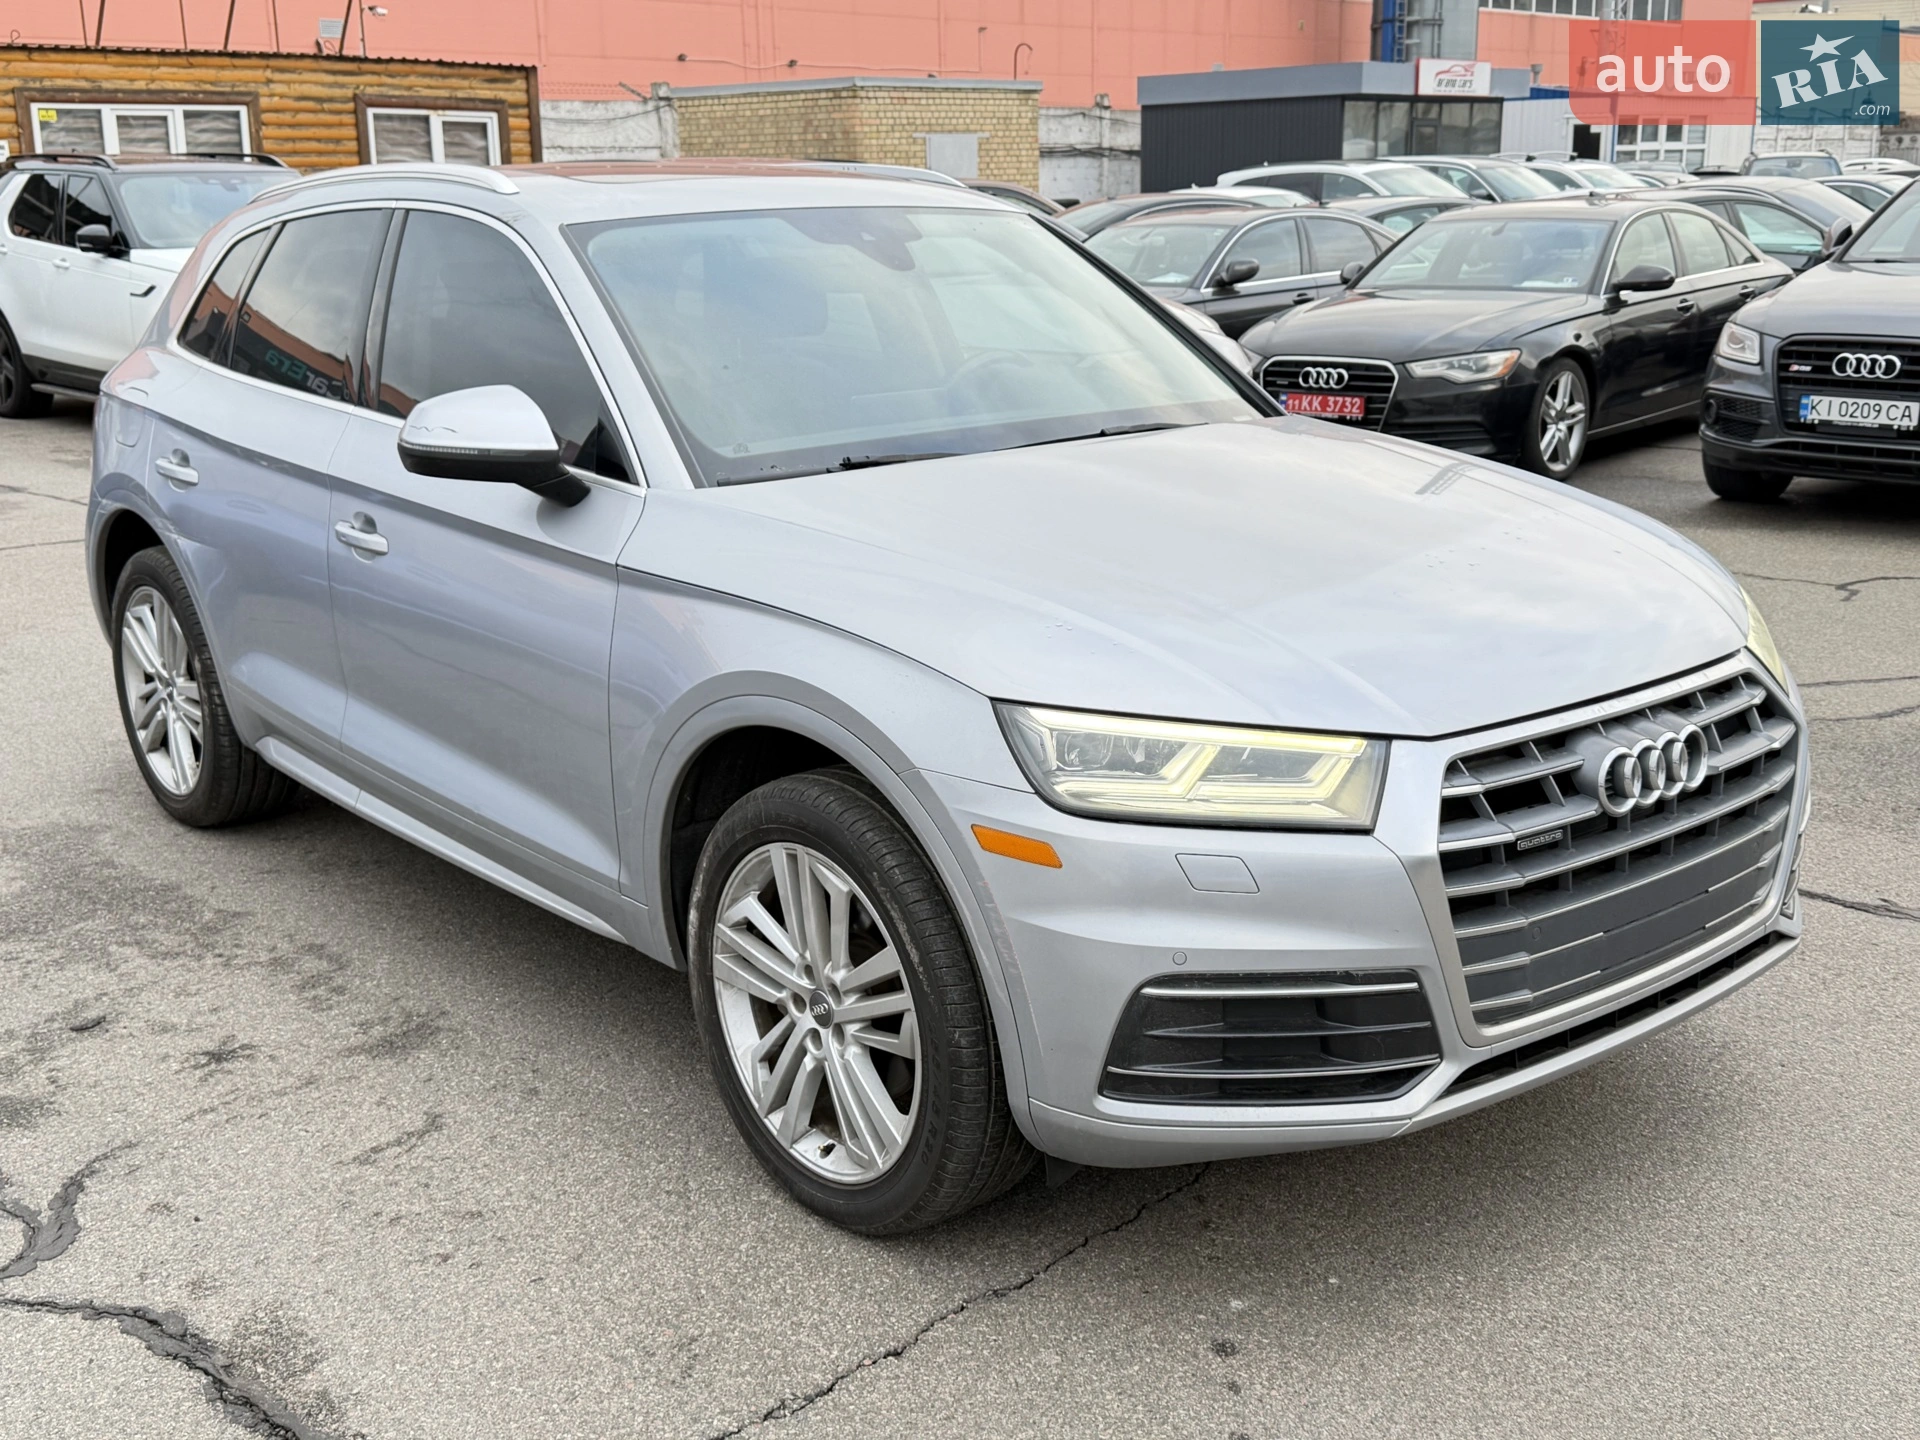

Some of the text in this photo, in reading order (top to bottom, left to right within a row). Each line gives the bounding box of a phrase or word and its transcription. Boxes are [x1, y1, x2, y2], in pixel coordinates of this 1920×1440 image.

[1326, 397, 1361, 413] 3732
[1838, 401, 1882, 420] 0209
[1886, 404, 1912, 422] CA
[1520, 832, 1562, 848] quattro
